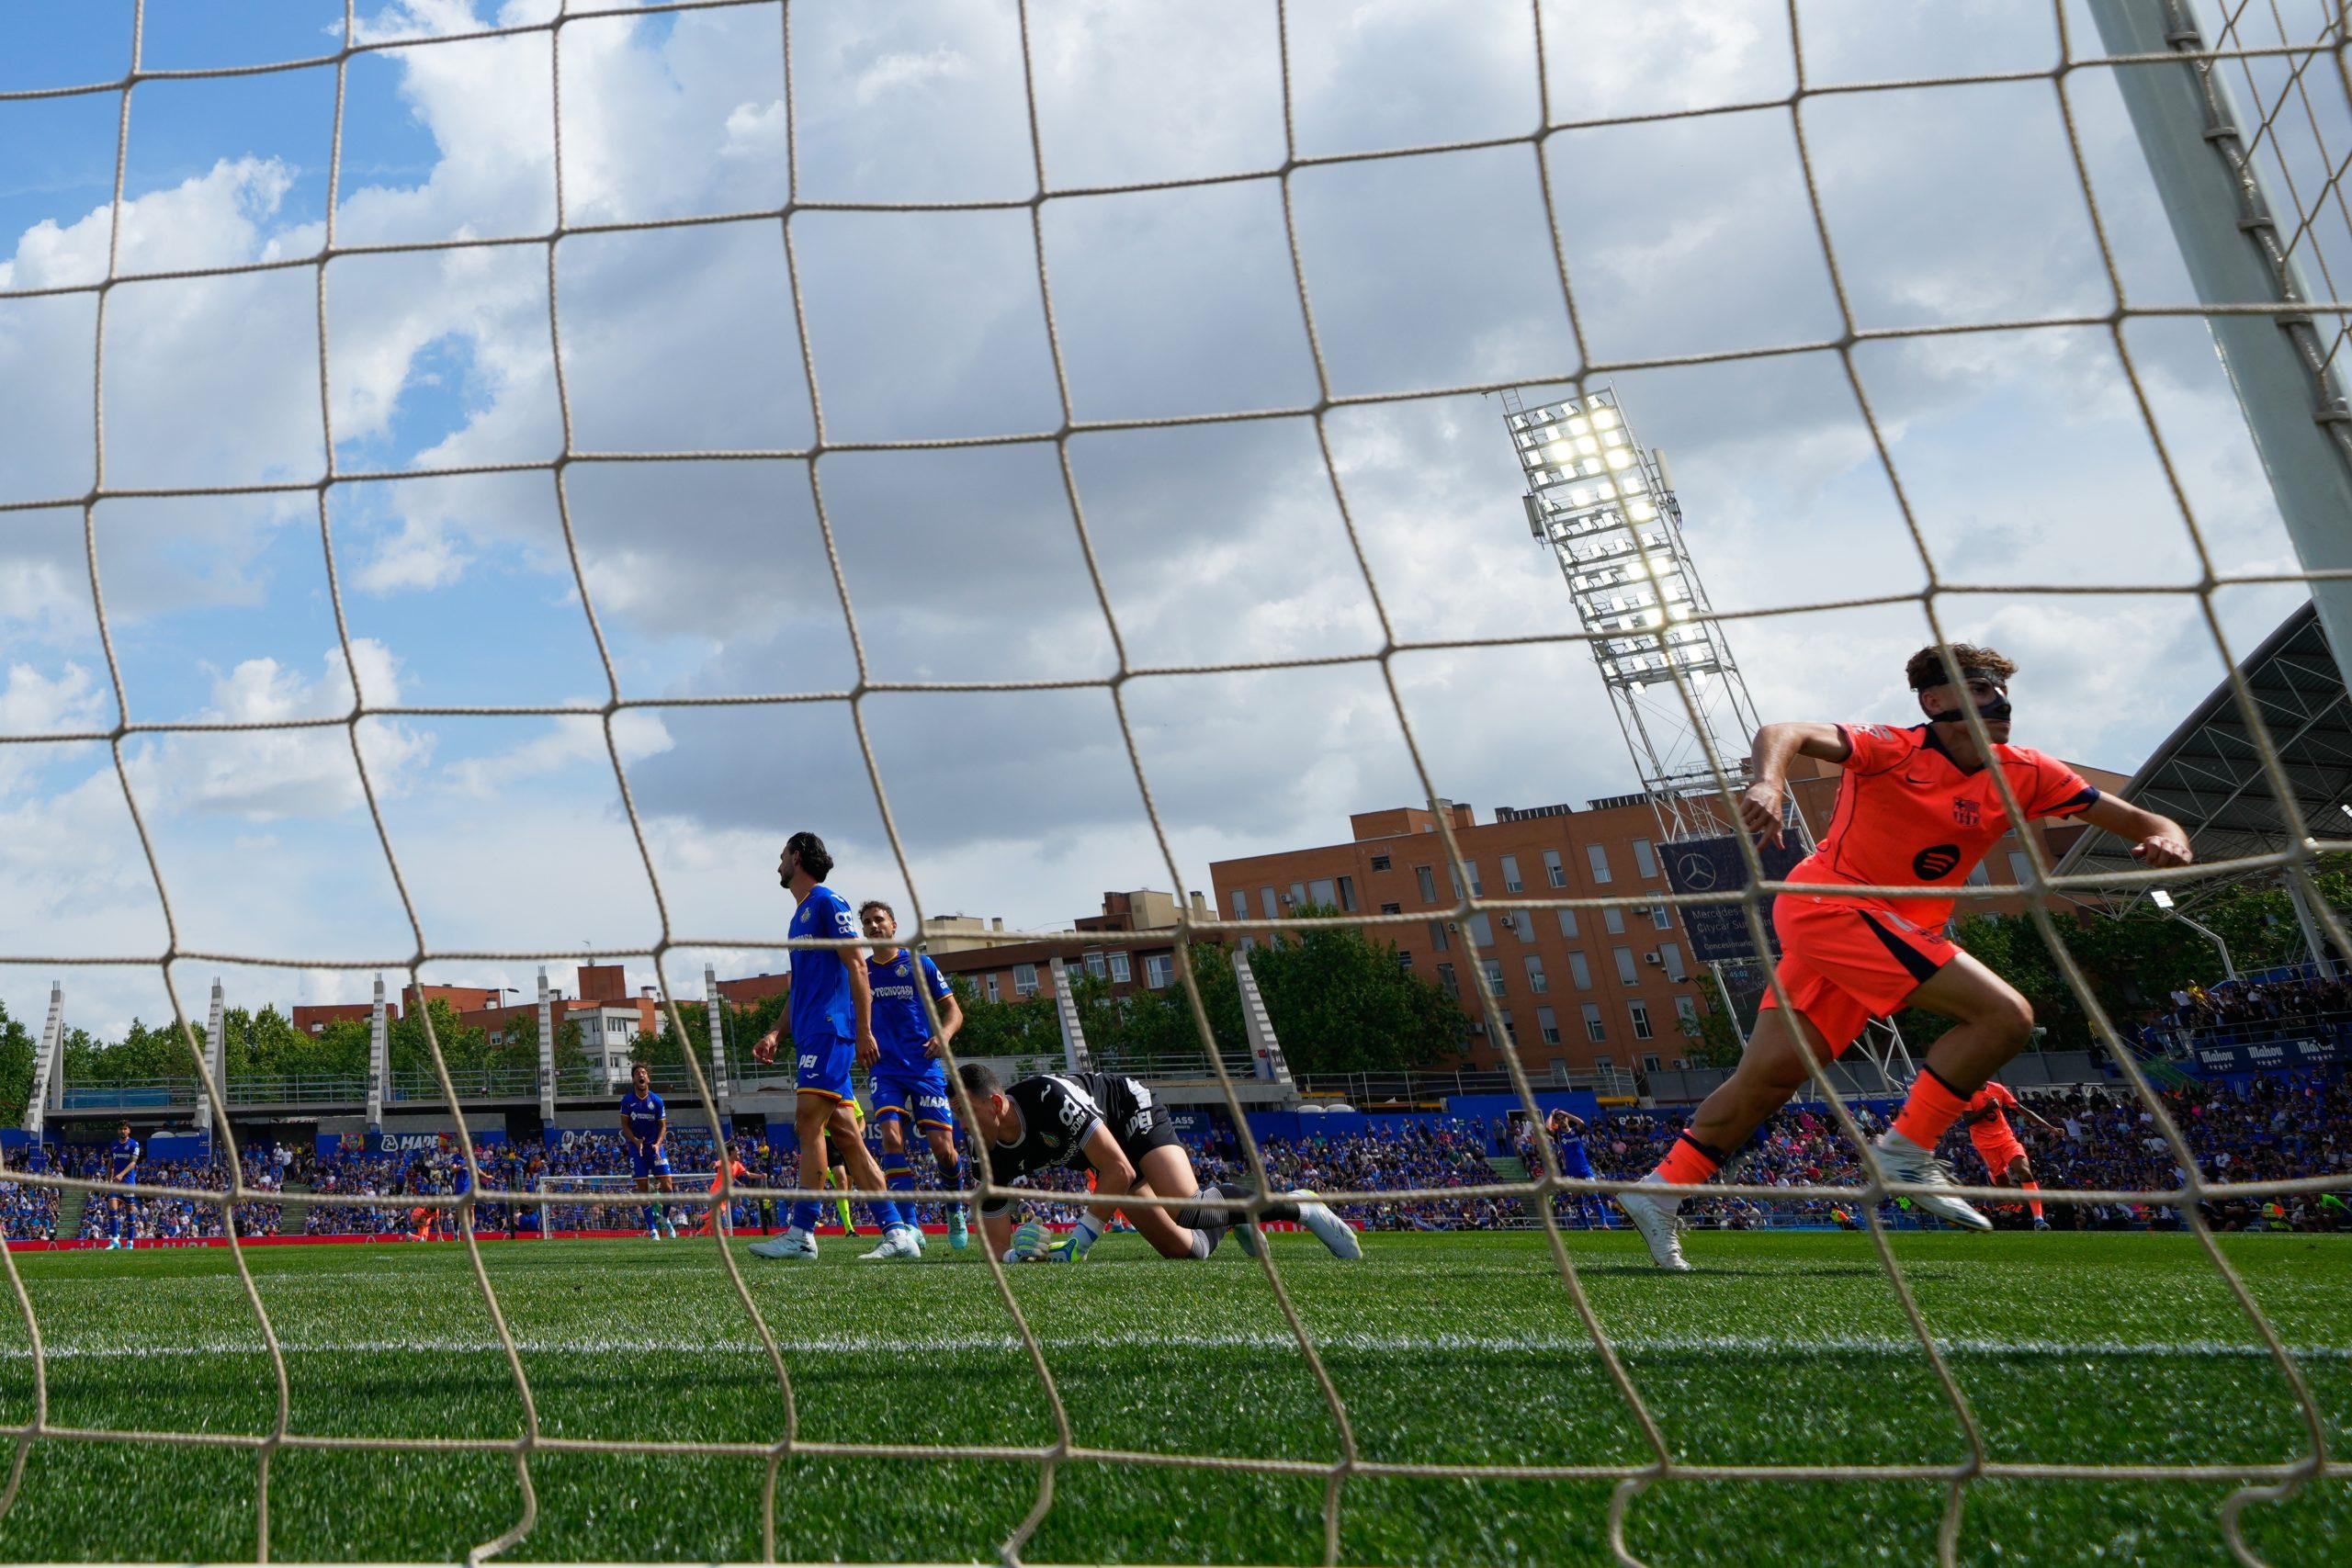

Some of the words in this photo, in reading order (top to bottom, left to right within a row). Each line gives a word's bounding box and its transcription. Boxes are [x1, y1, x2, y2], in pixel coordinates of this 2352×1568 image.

[1691, 904, 1766, 919] Mercedes-Bz
[1703, 940, 1754, 951] Concesionario
[874, 985, 913, 998] TECNOCASA
[2200, 1050, 2234, 1064] Mahou
[2247, 1045, 2283, 1059] Mahou
[798, 1055, 818, 1068] PEI
[920, 1095, 951, 1111] MAPE
[1125, 1110, 1153, 1140] APEI
[1168, 1116, 1194, 1125] LASS
[400, 1135, 440, 1150] MAPE
